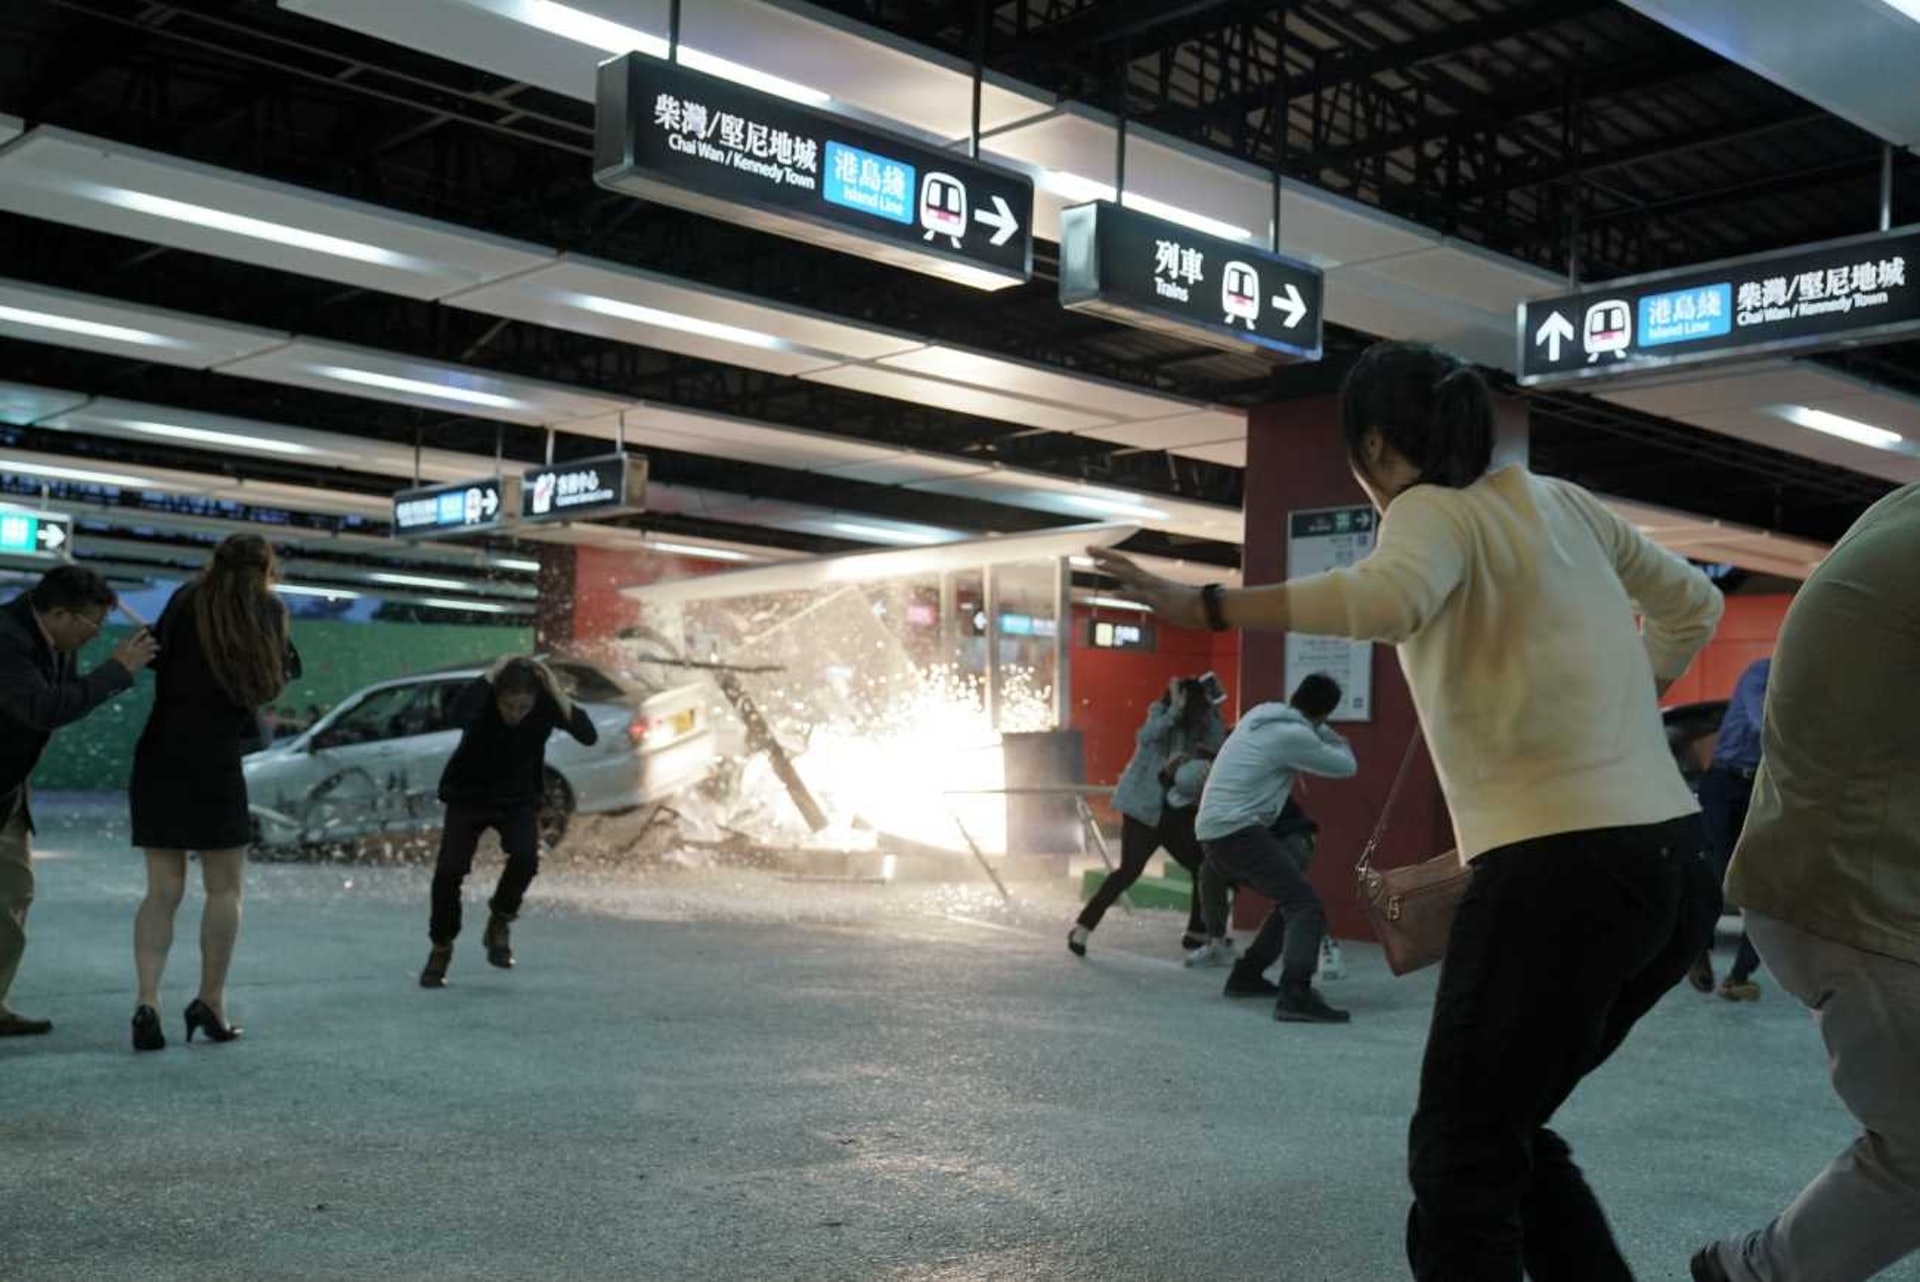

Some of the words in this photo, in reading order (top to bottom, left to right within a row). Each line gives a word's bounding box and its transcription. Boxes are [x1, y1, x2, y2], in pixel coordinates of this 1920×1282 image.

[654, 94, 818, 172] 柴灣/堅尼地城
[668, 133, 697, 156] Chai
[698, 142, 724, 164] Wan
[725, 151, 735, 166] /
[734, 151, 784, 184] Kennedy
[784, 166, 815, 190] Town
[1155, 240, 1204, 284] 列車
[1155, 276, 1188, 302] Trains
[1737, 308, 1763, 326] Chai
